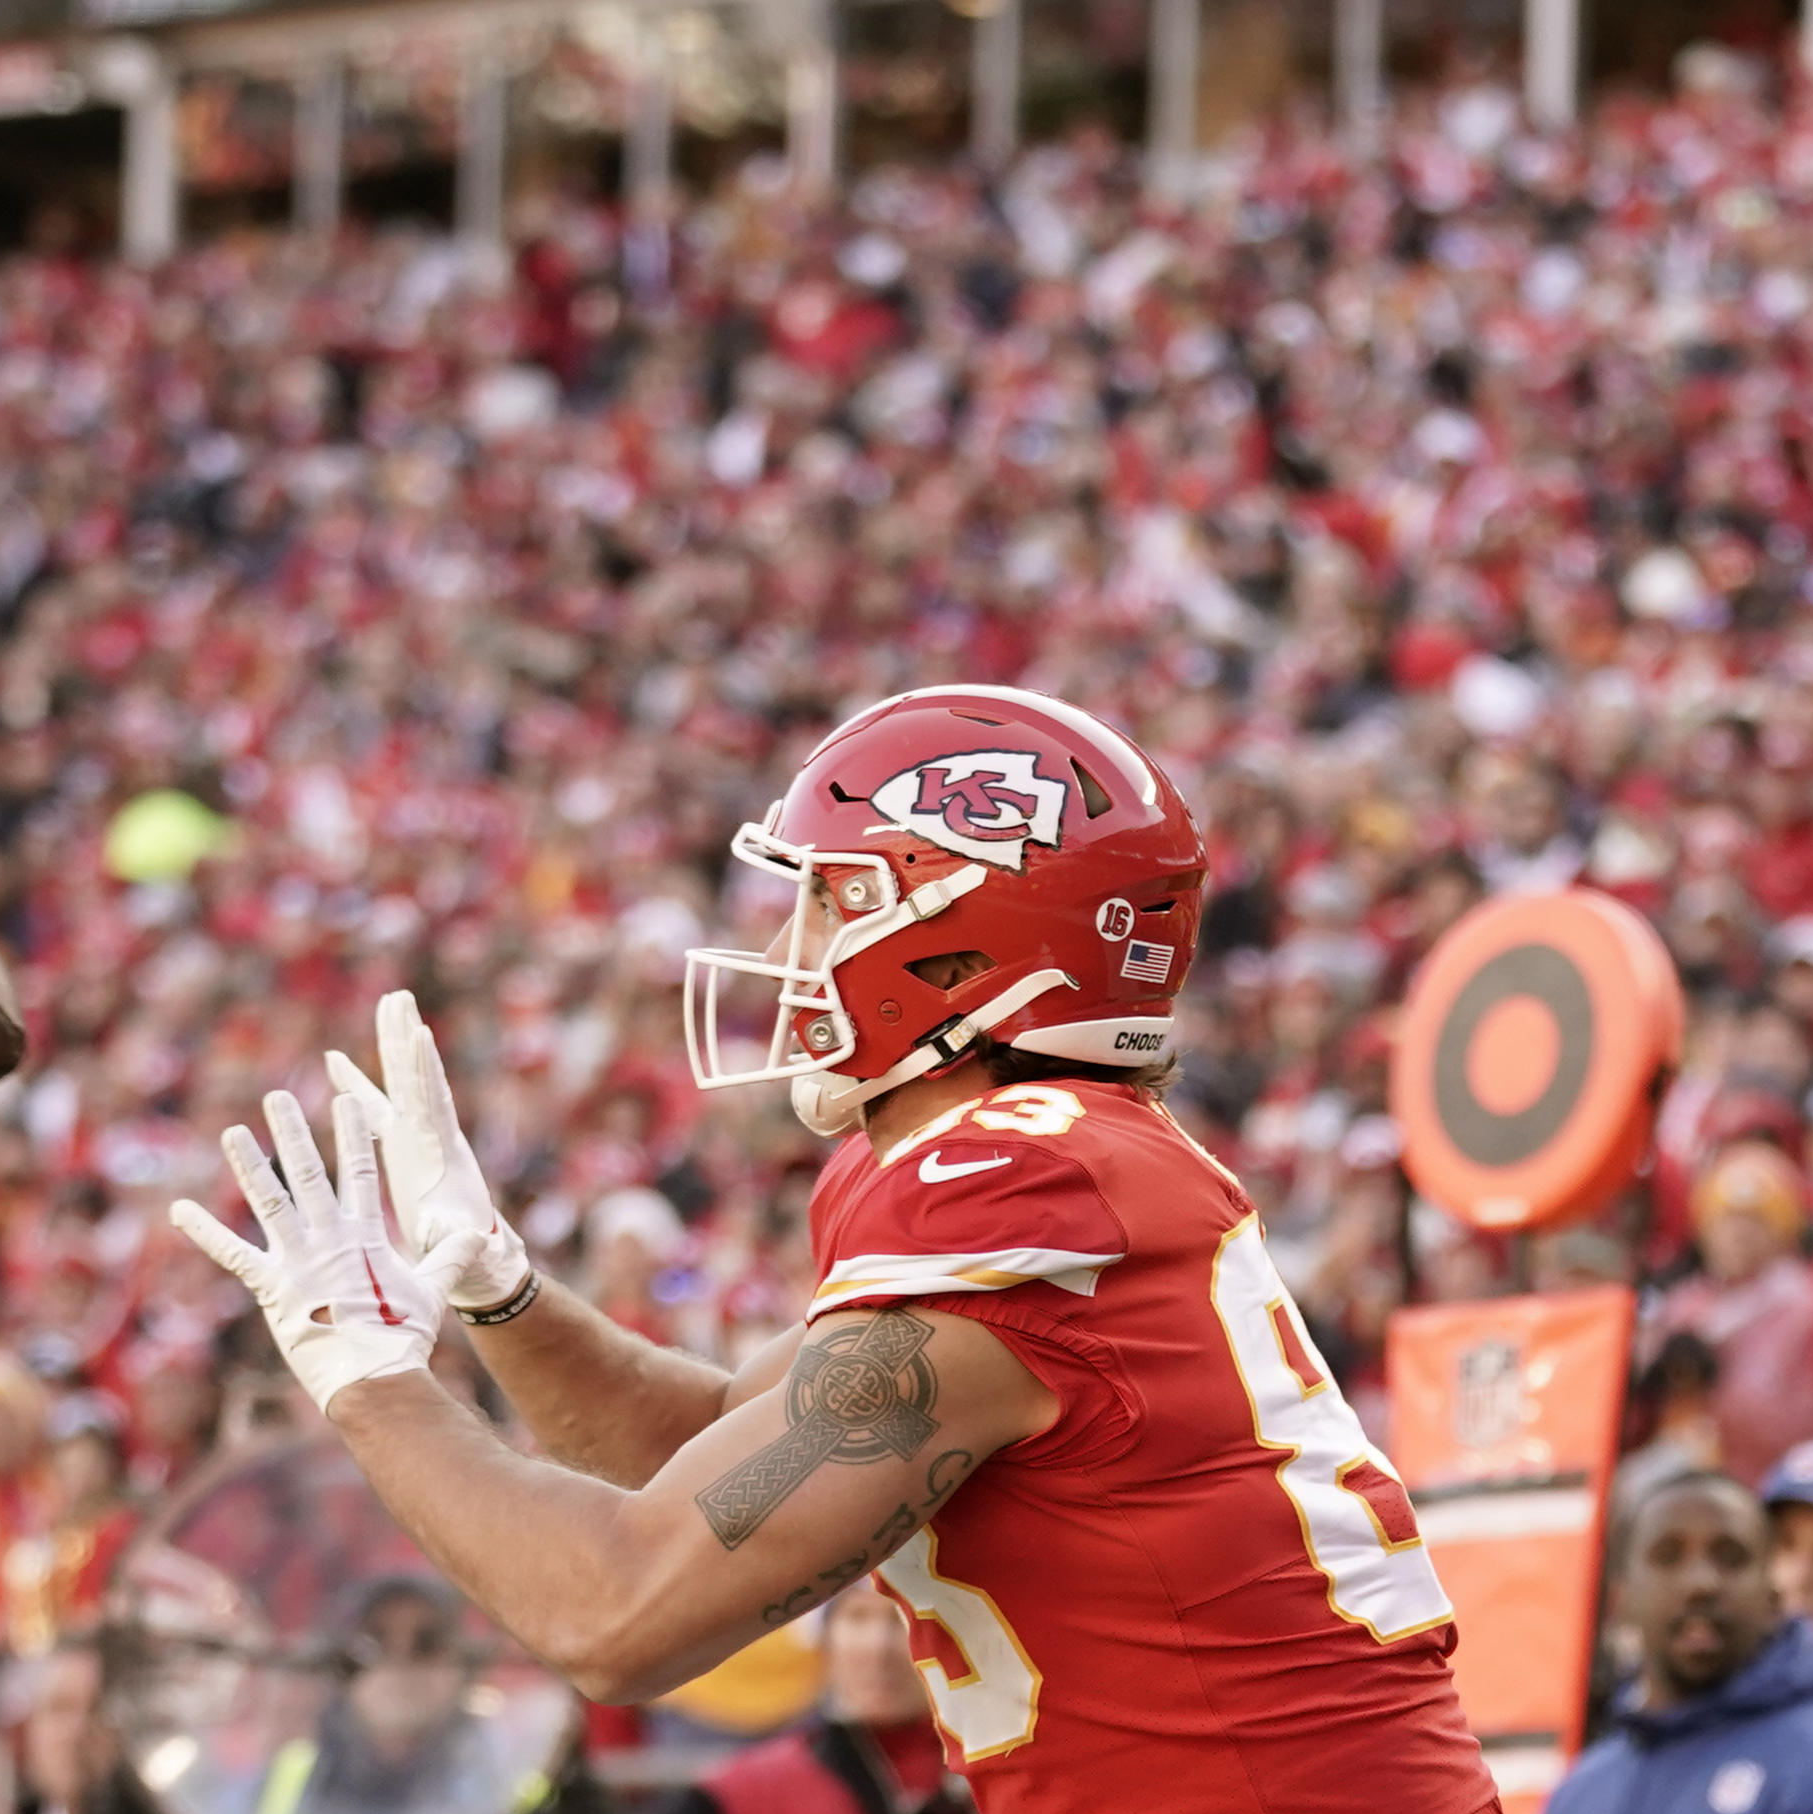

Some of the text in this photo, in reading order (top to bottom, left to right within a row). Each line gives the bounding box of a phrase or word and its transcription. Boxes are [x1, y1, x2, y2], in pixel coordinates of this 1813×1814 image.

[911, 767, 1039, 842] KC
[1101, 903, 1131, 937] 16
[949, 1022, 974, 1048] 83
